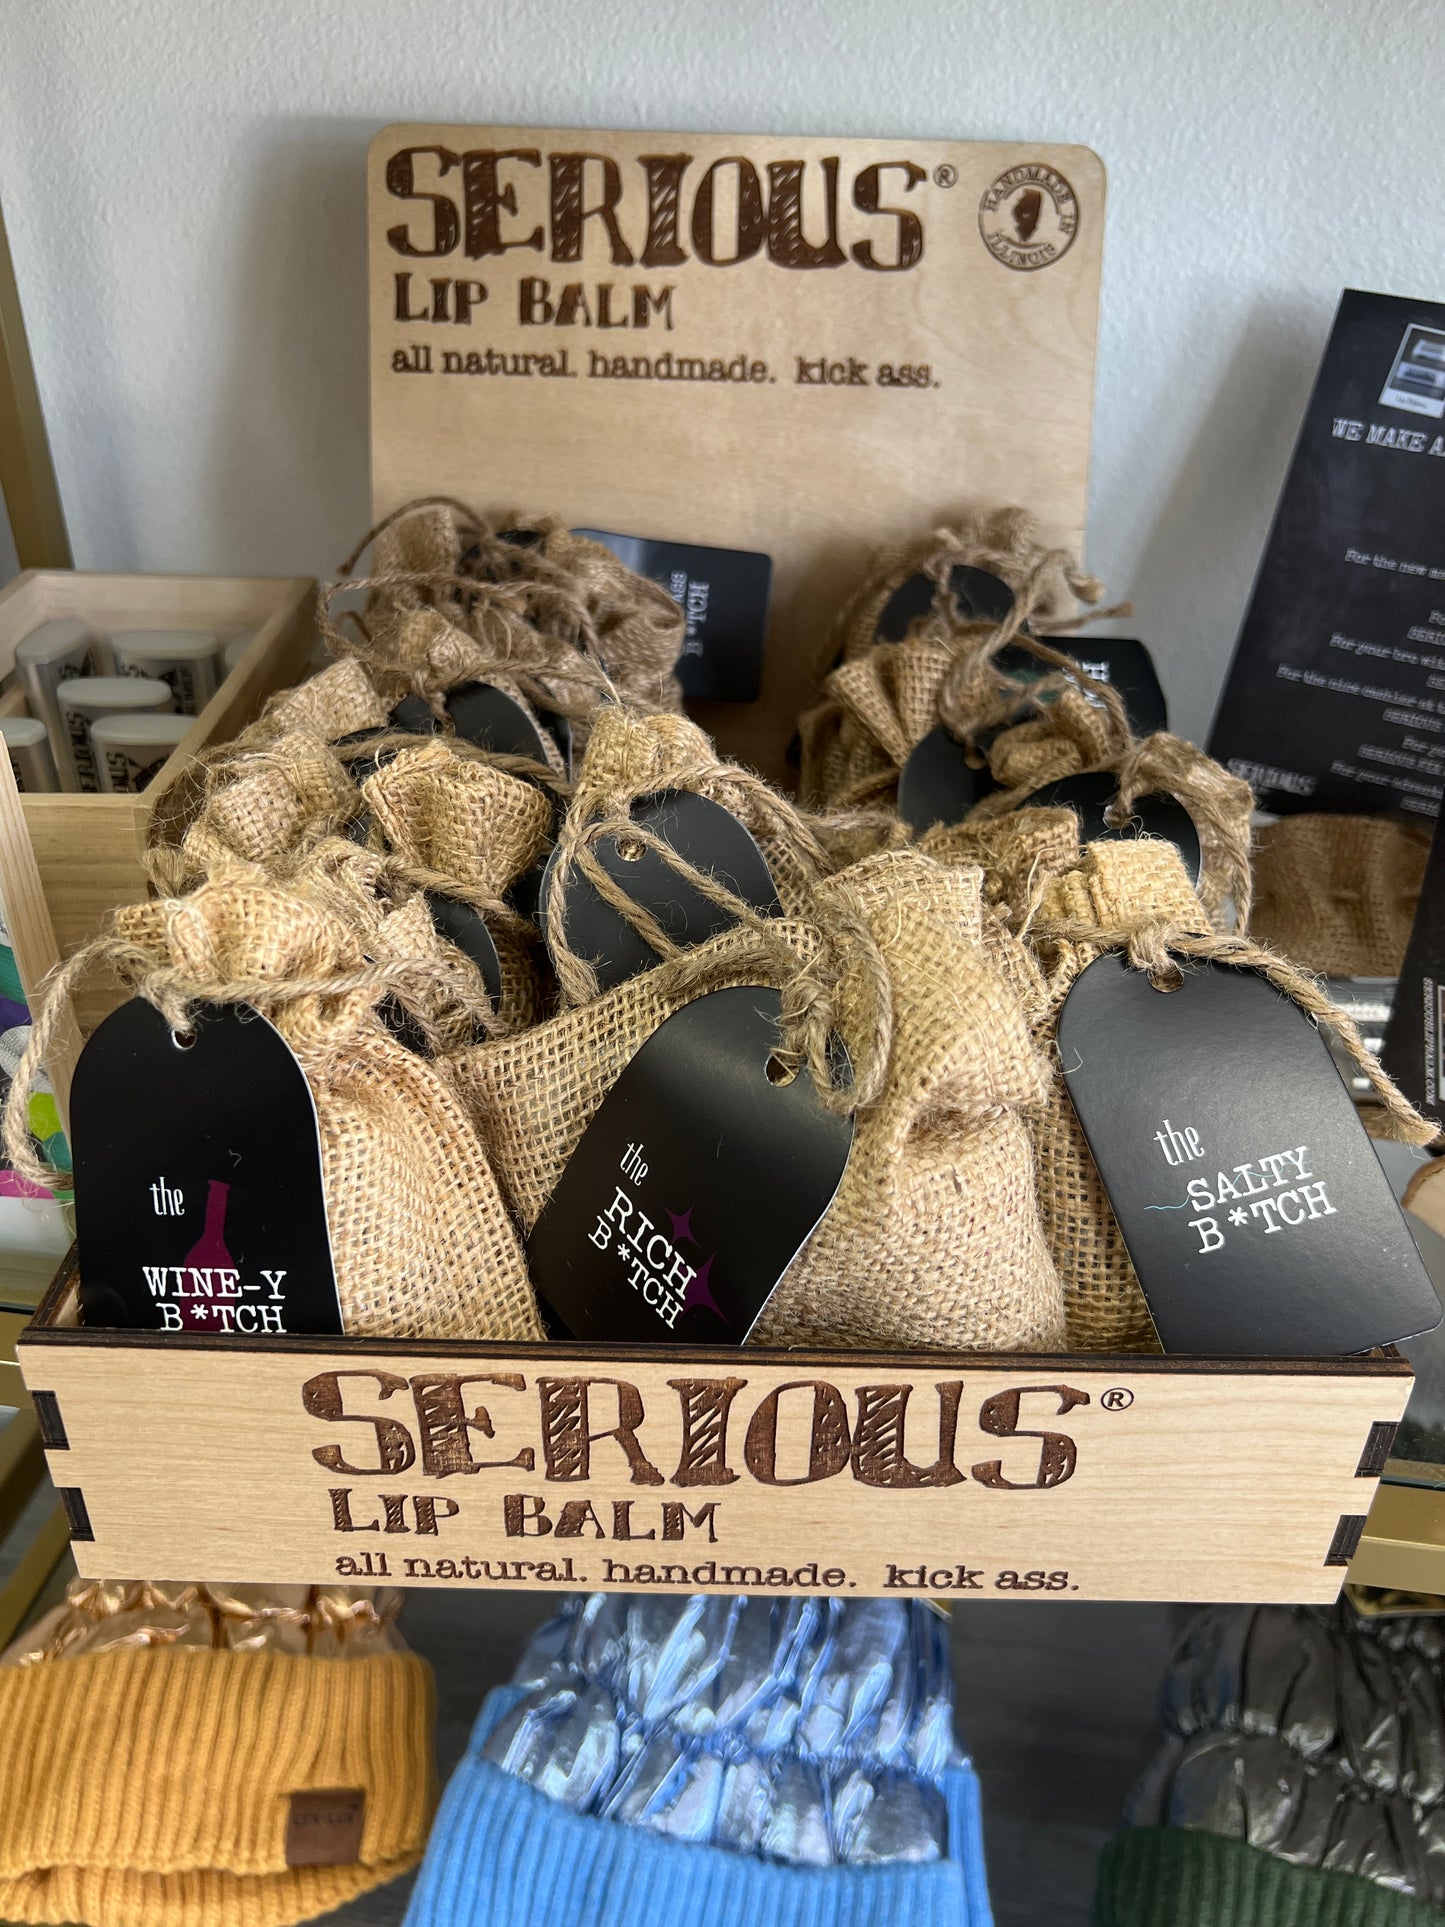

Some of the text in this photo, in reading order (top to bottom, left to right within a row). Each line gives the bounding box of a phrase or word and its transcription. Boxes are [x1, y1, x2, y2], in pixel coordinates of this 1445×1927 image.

[984, 166, 1073, 212] HANDMADE
[394, 272, 676, 330] LIP BALM
[392, 344, 941, 388] all natural. handmade. kick ass.
[1331, 418, 1363, 441] WE
[1366, 424, 1426, 453] MAKE
[620, 1142, 649, 1186] the
[1153, 1119, 1205, 1166] the
[149, 1176, 185, 1216] the
[1187, 1145, 1314, 1212] SALTY
[604, 1186, 698, 1300] RICH
[142, 1266, 288, 1300] WINE-Y
[328, 1488, 722, 1543] LIP BALM
[335, 1551, 1080, 1591] all natural. handmade. kick ass.
